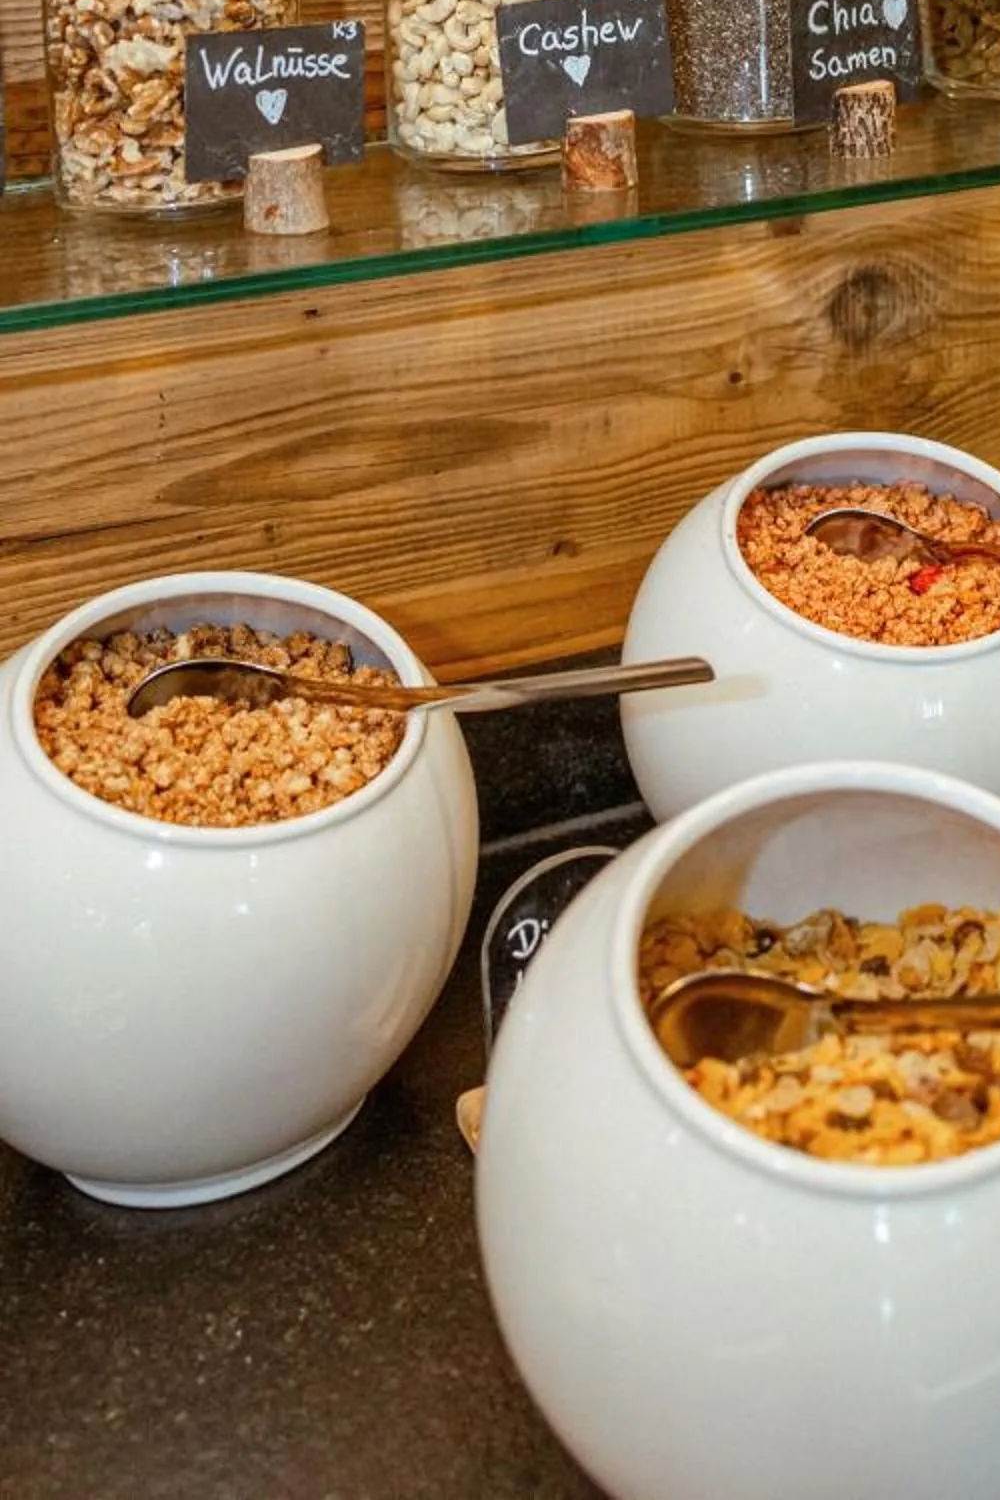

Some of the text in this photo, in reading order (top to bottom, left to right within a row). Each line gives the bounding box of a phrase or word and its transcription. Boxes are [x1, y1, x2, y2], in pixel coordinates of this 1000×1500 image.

[332, 21, 357, 40] K3
[519, 8, 642, 56] Cashew
[809, 48, 897, 80] Samen
